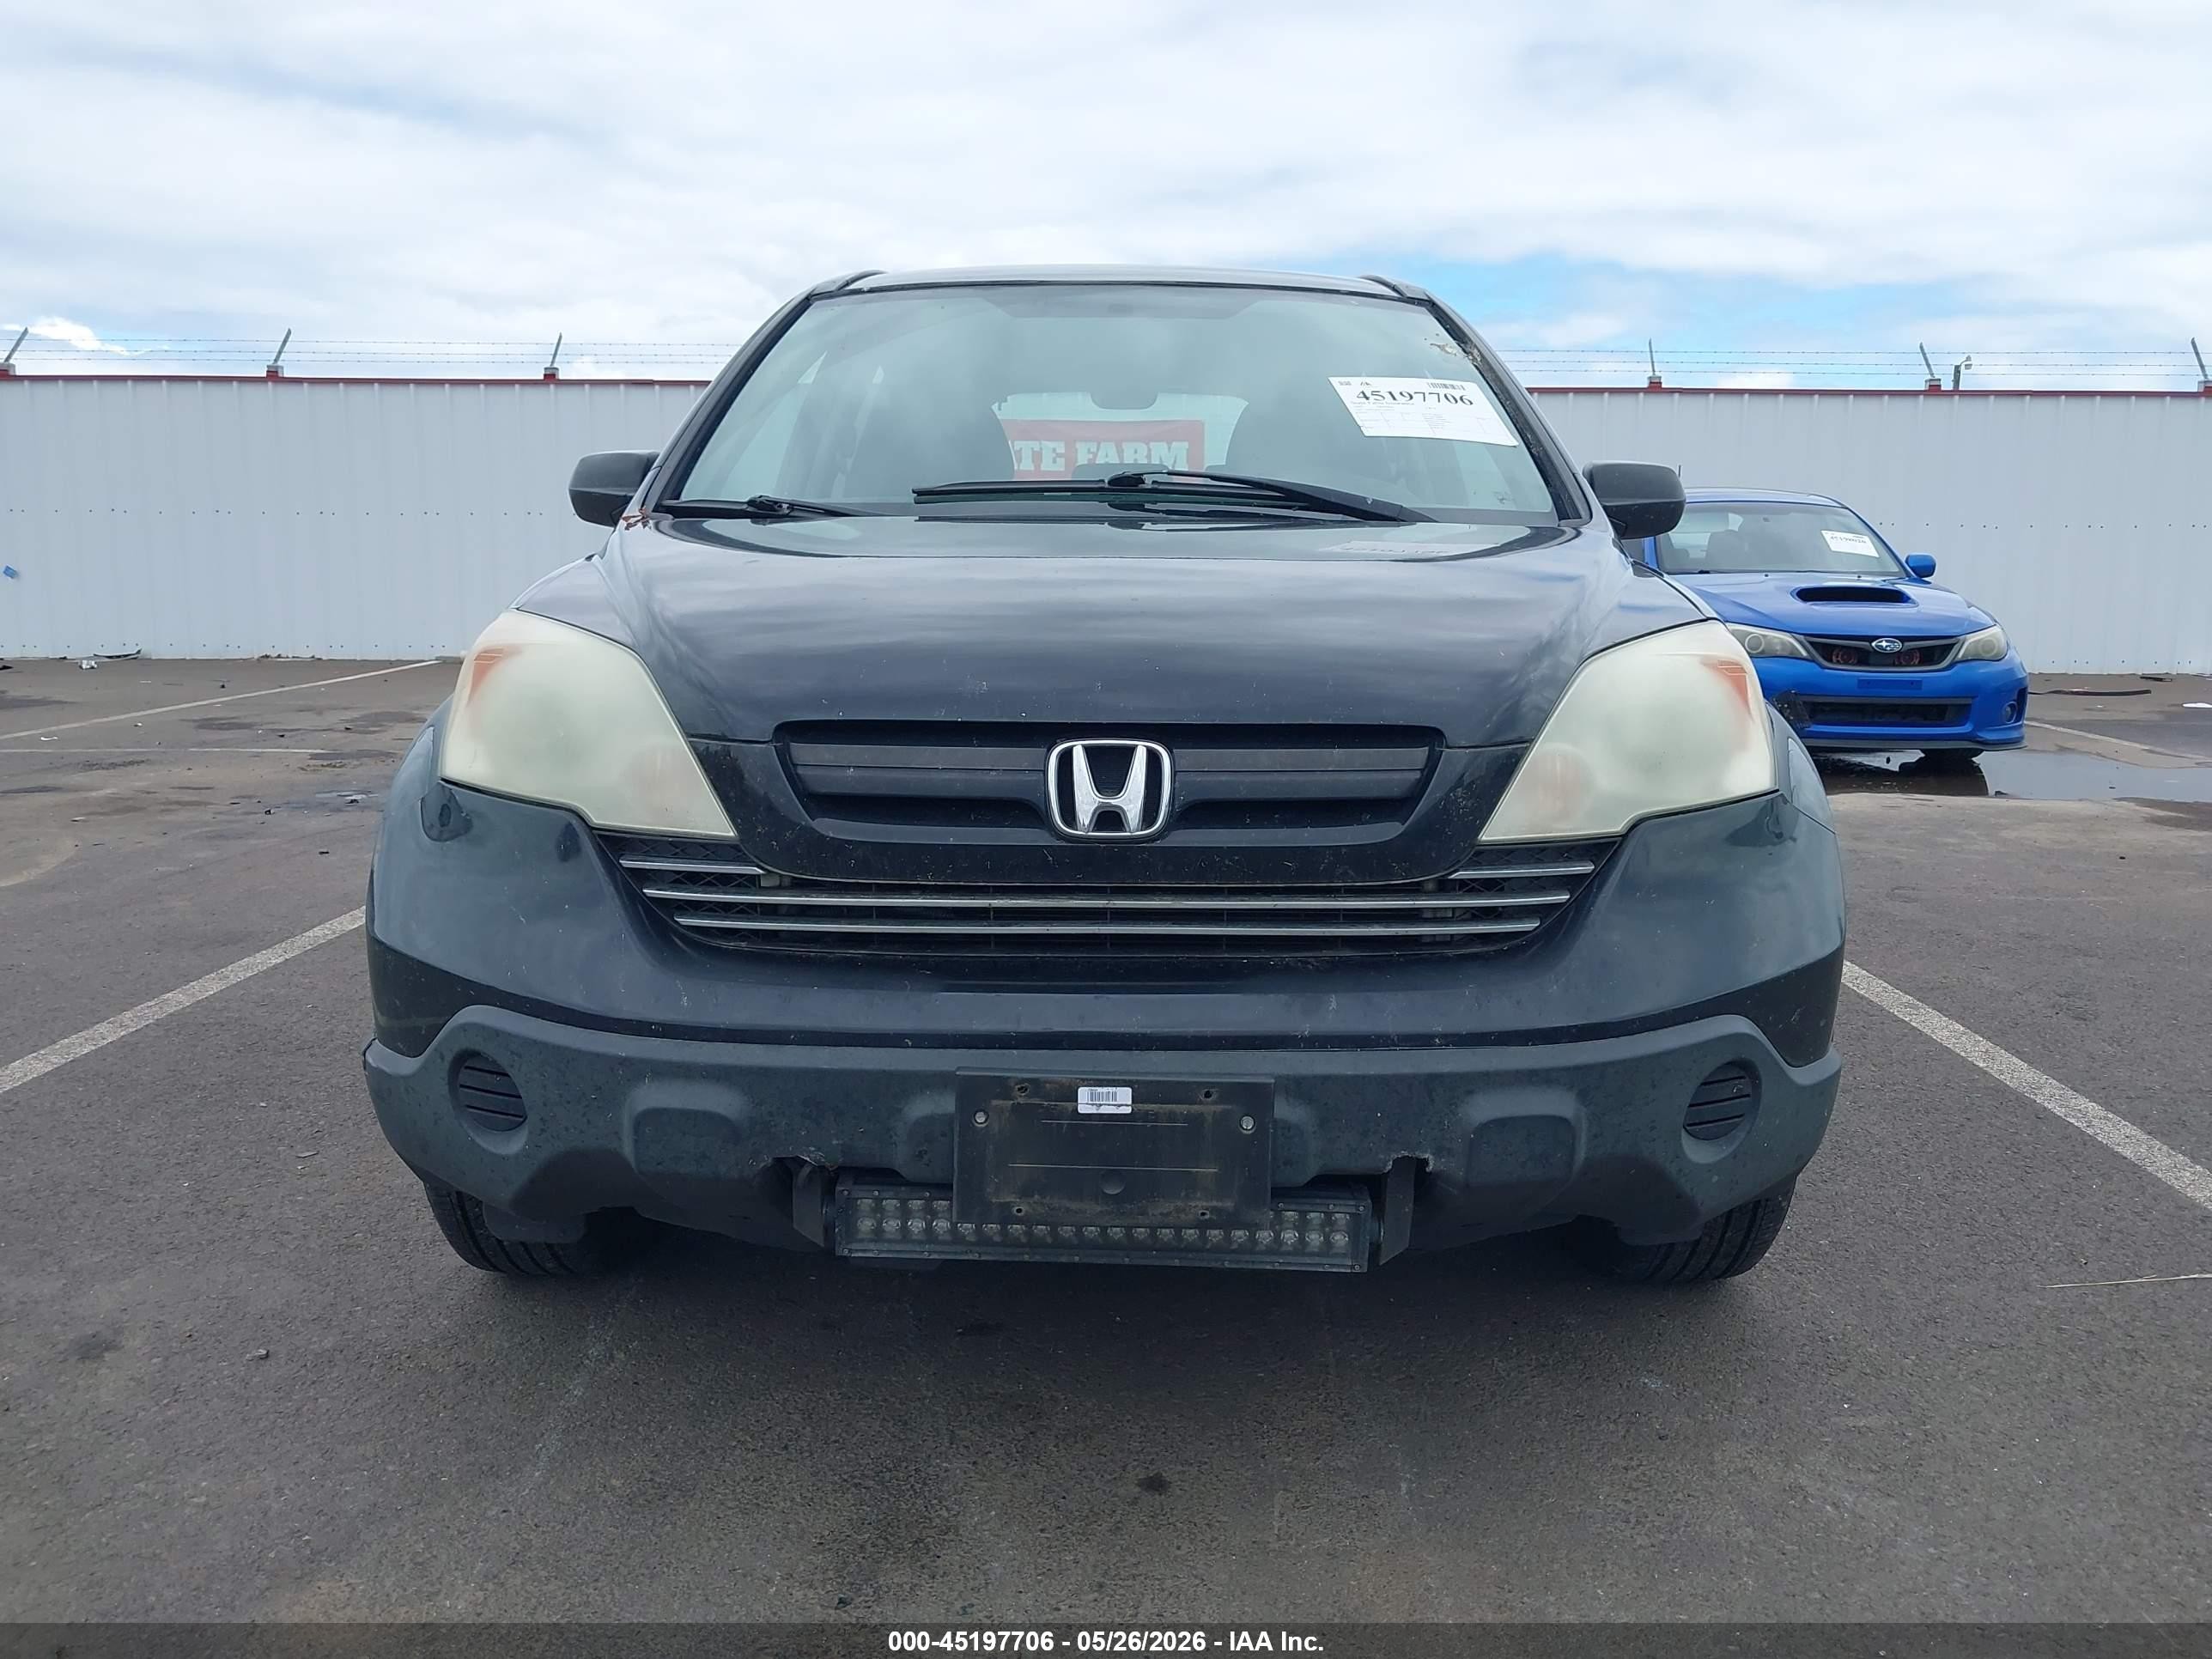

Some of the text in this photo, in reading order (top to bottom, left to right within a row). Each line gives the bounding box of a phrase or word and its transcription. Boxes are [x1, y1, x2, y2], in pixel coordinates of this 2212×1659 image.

[1356, 390, 1474, 406] 45197706
[1008, 440, 1189, 471] TE FARM
